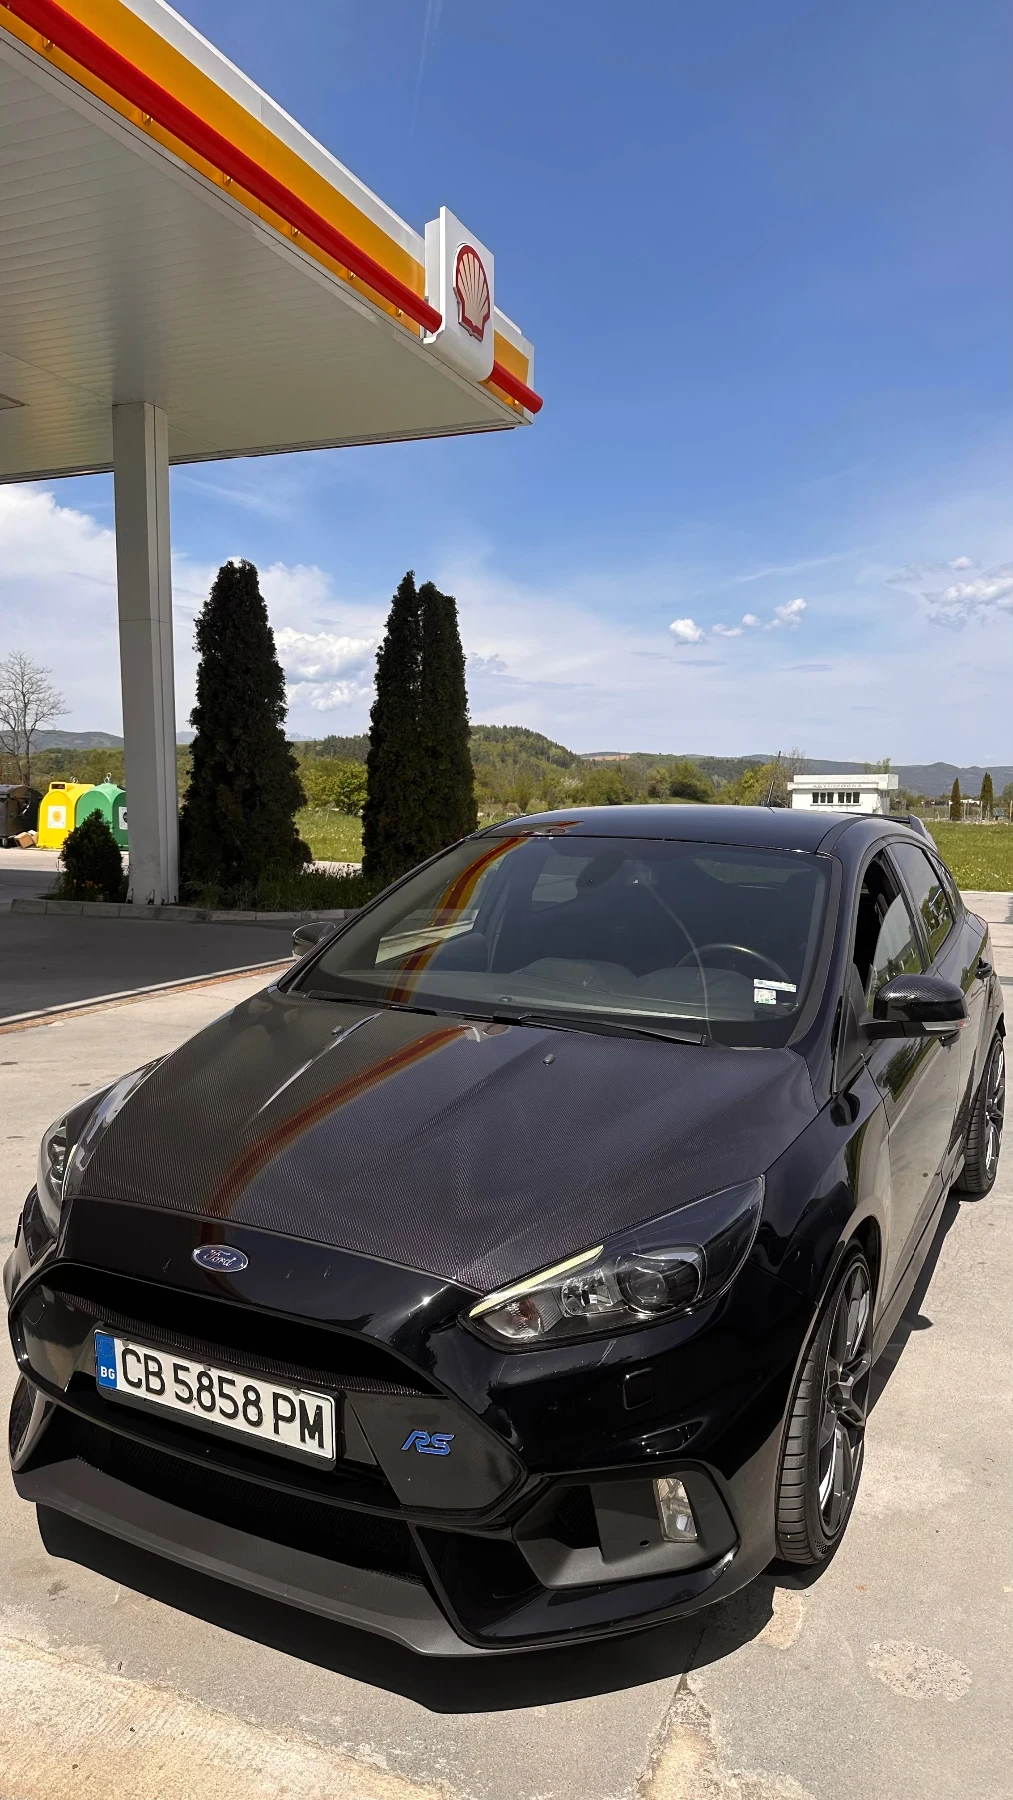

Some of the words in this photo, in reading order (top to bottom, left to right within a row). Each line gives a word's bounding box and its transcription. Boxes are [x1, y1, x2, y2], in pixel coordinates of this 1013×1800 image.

[203, 1249, 237, 1267] Ford
[100, 1365, 115, 1380] BG
[121, 1347, 166, 1396] CB
[172, 1362, 264, 1427] 5858
[272, 1391, 325, 1449] PM
[401, 1430, 455, 1456] RS
